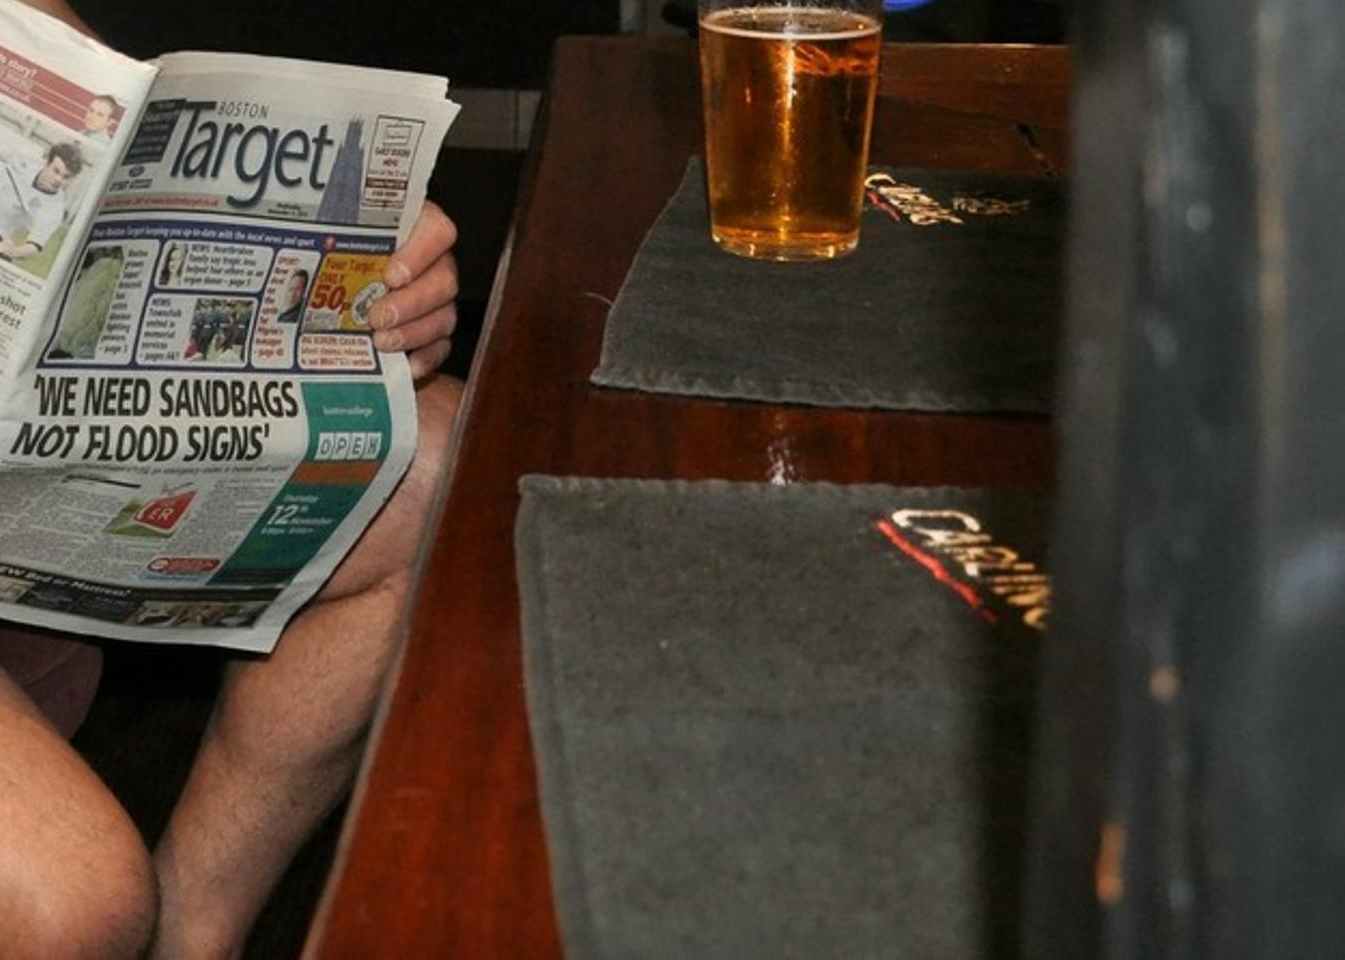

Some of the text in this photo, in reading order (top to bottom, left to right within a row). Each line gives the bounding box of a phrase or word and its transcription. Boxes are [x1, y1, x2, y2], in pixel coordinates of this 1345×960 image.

[218, 101, 269, 118] BOSTON
[171, 100, 334, 208] Target
[235, 231, 246, 240] the
[34, 374, 299, 418] 'WE NEED SANDBAGS
[10, 422, 270, 463] NOT FLOOD SIGNS'
[320, 437, 378, 455] OPEN
